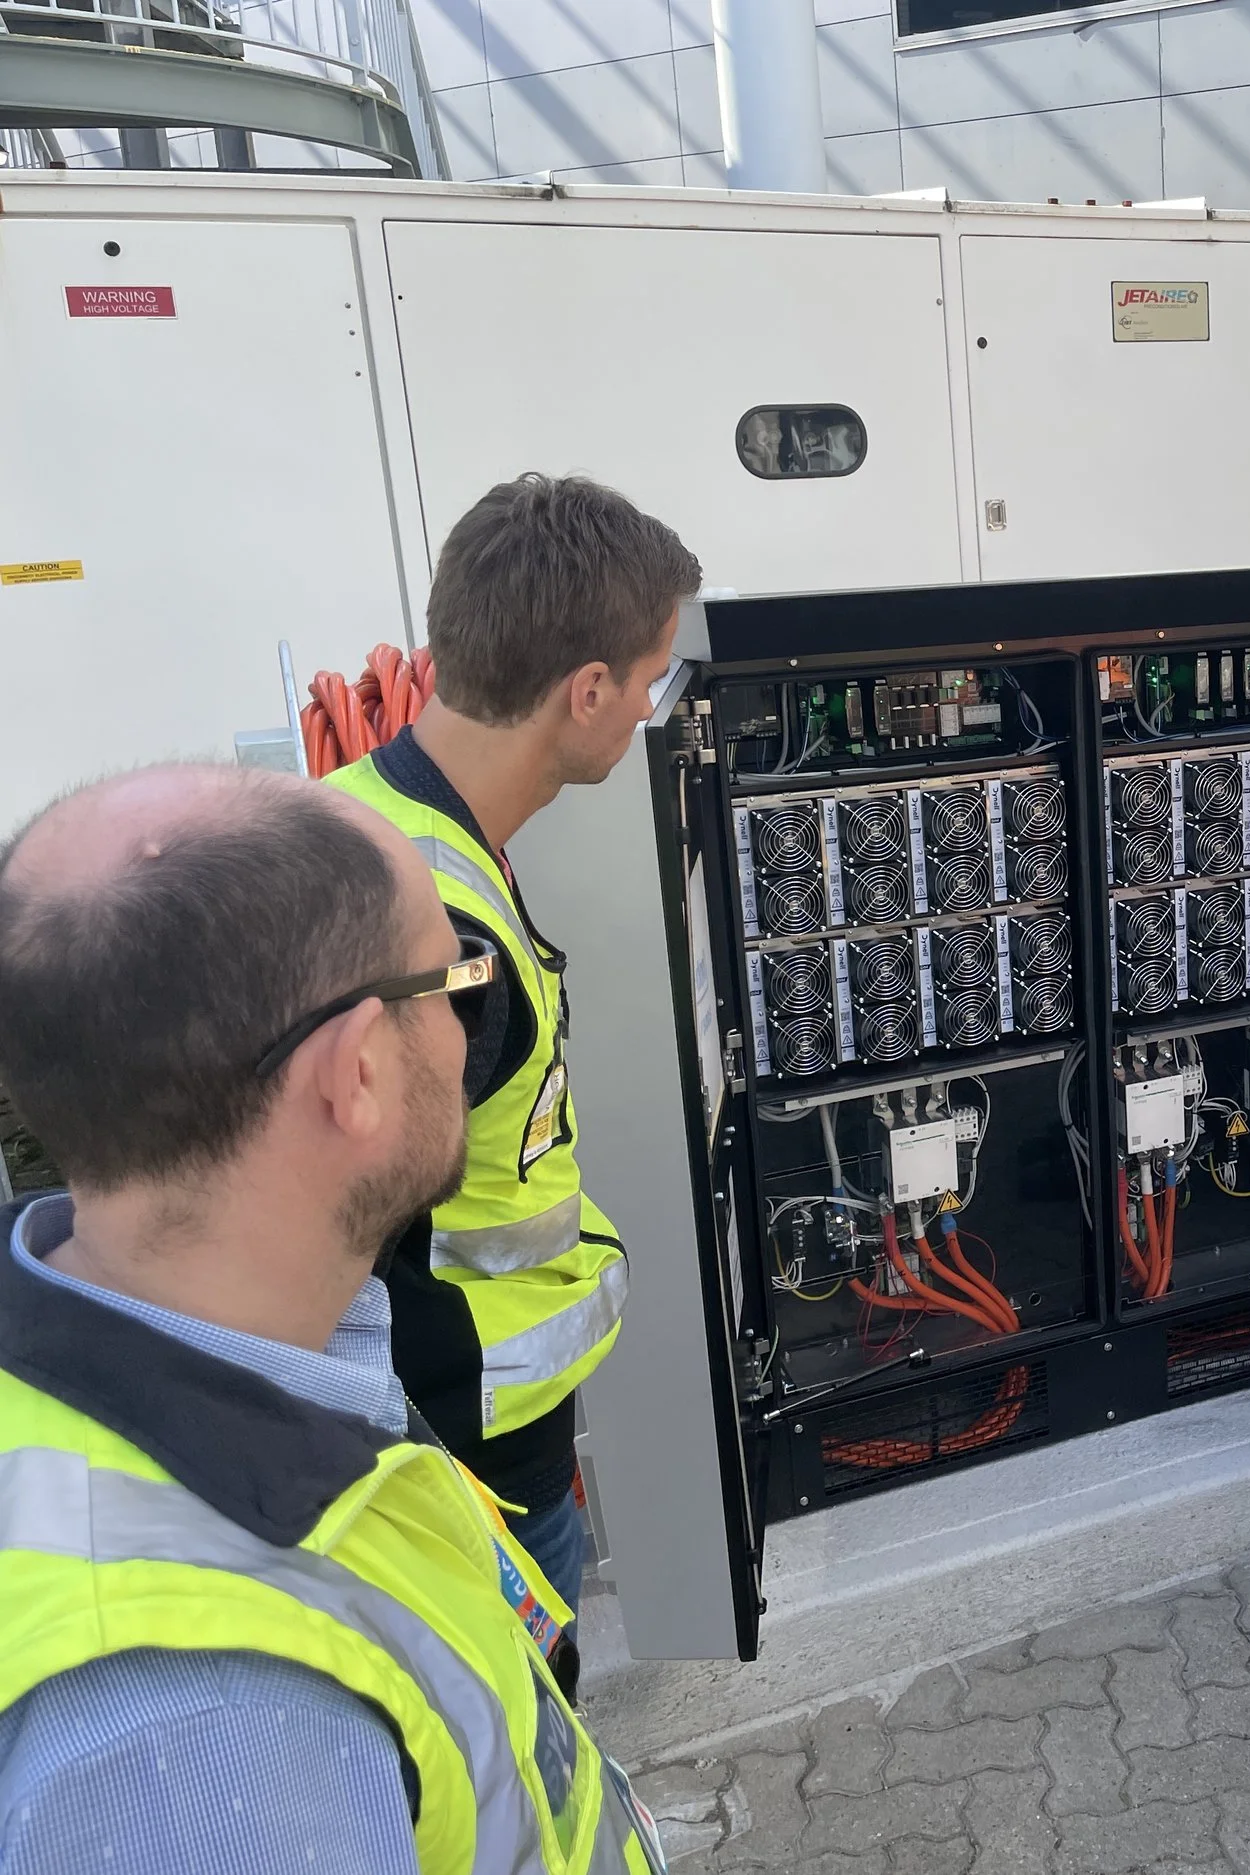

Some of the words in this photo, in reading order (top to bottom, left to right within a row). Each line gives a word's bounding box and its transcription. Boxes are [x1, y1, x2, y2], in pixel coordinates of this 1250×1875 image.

[82, 291, 157, 303] WARNING
[83, 305, 109, 313] HIGH
[111, 304, 160, 313] VOLTAGE
[22, 563, 60, 572] CAUTION
